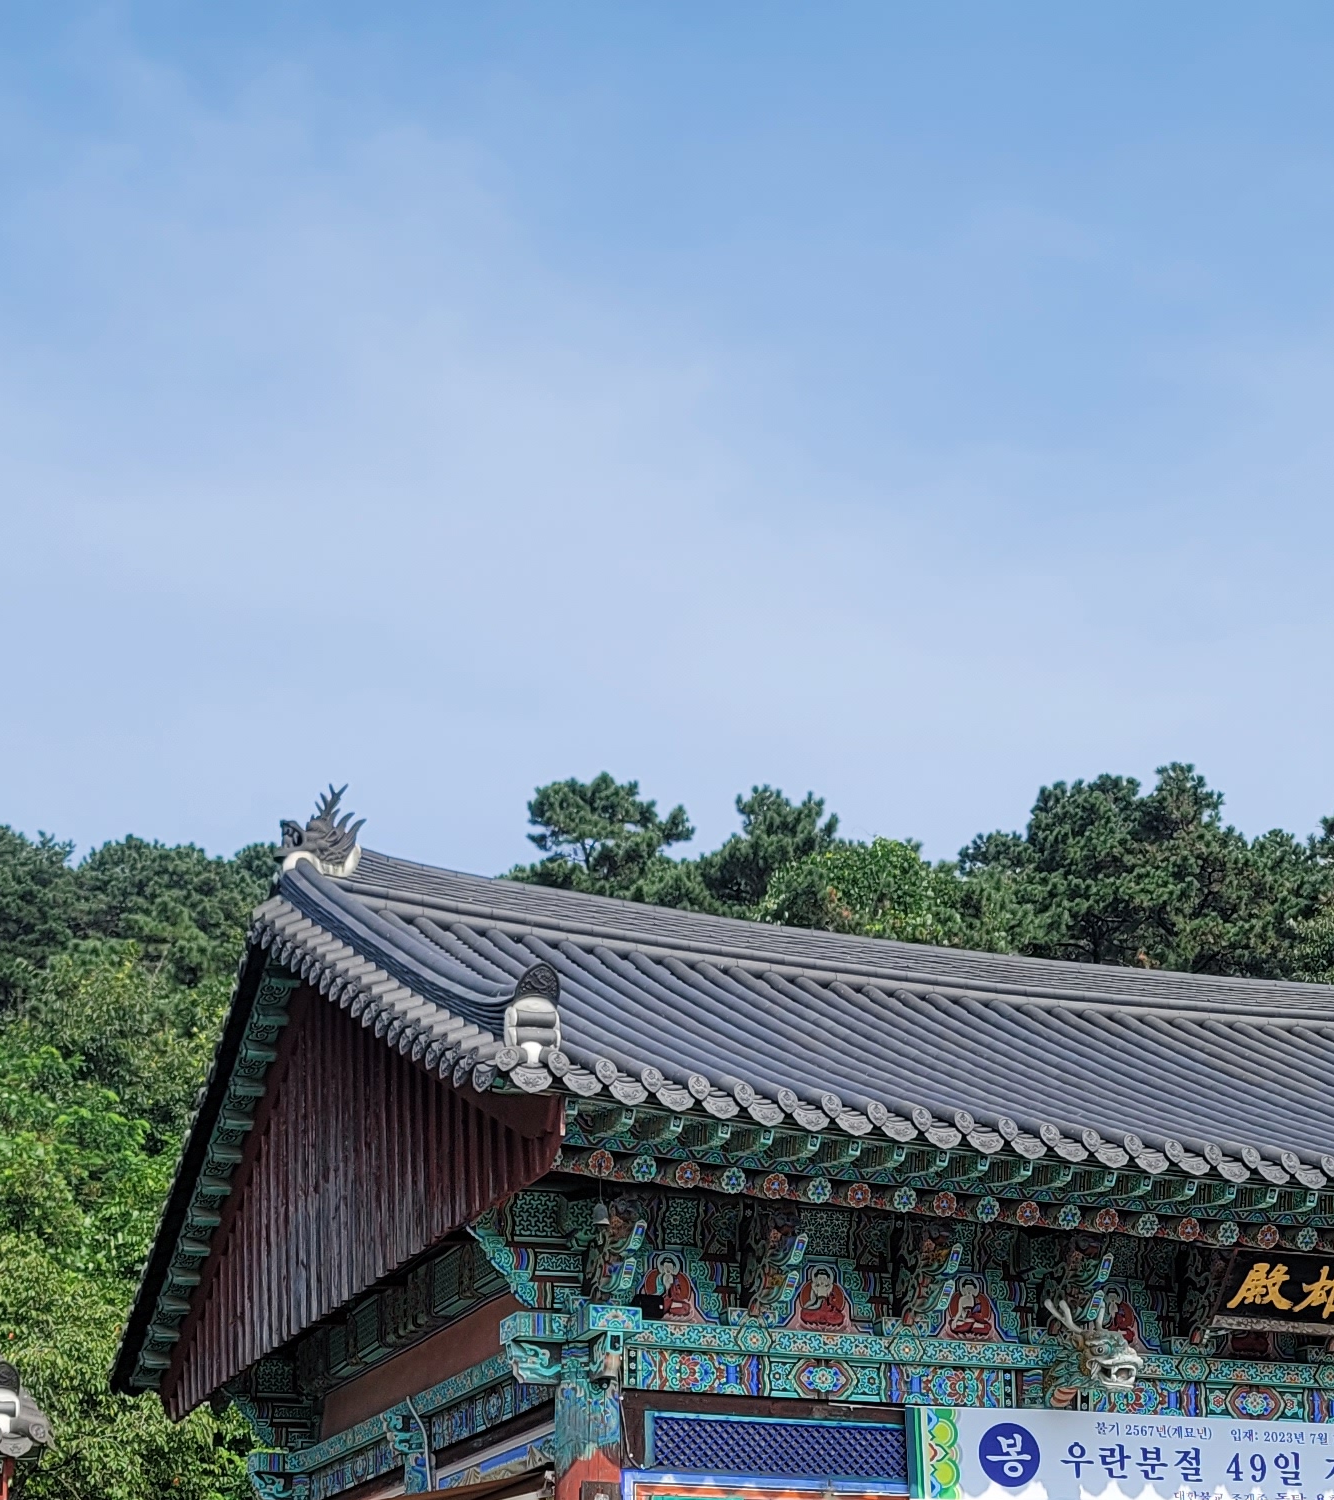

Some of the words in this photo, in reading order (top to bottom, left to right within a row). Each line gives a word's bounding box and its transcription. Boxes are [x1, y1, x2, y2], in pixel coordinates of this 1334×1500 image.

[986, 1433, 1032, 1478] 봉
[1095, 1421, 1120, 1436] 불기
[1230, 1428, 1259, 1442] 입재:
[1263, 1431, 1305, 1445] 2023년
[1309, 1432, 1328, 1446] 7월
[1060, 1441, 1204, 1483] 우란분절
[1226, 1452, 1303, 1486] 49일
